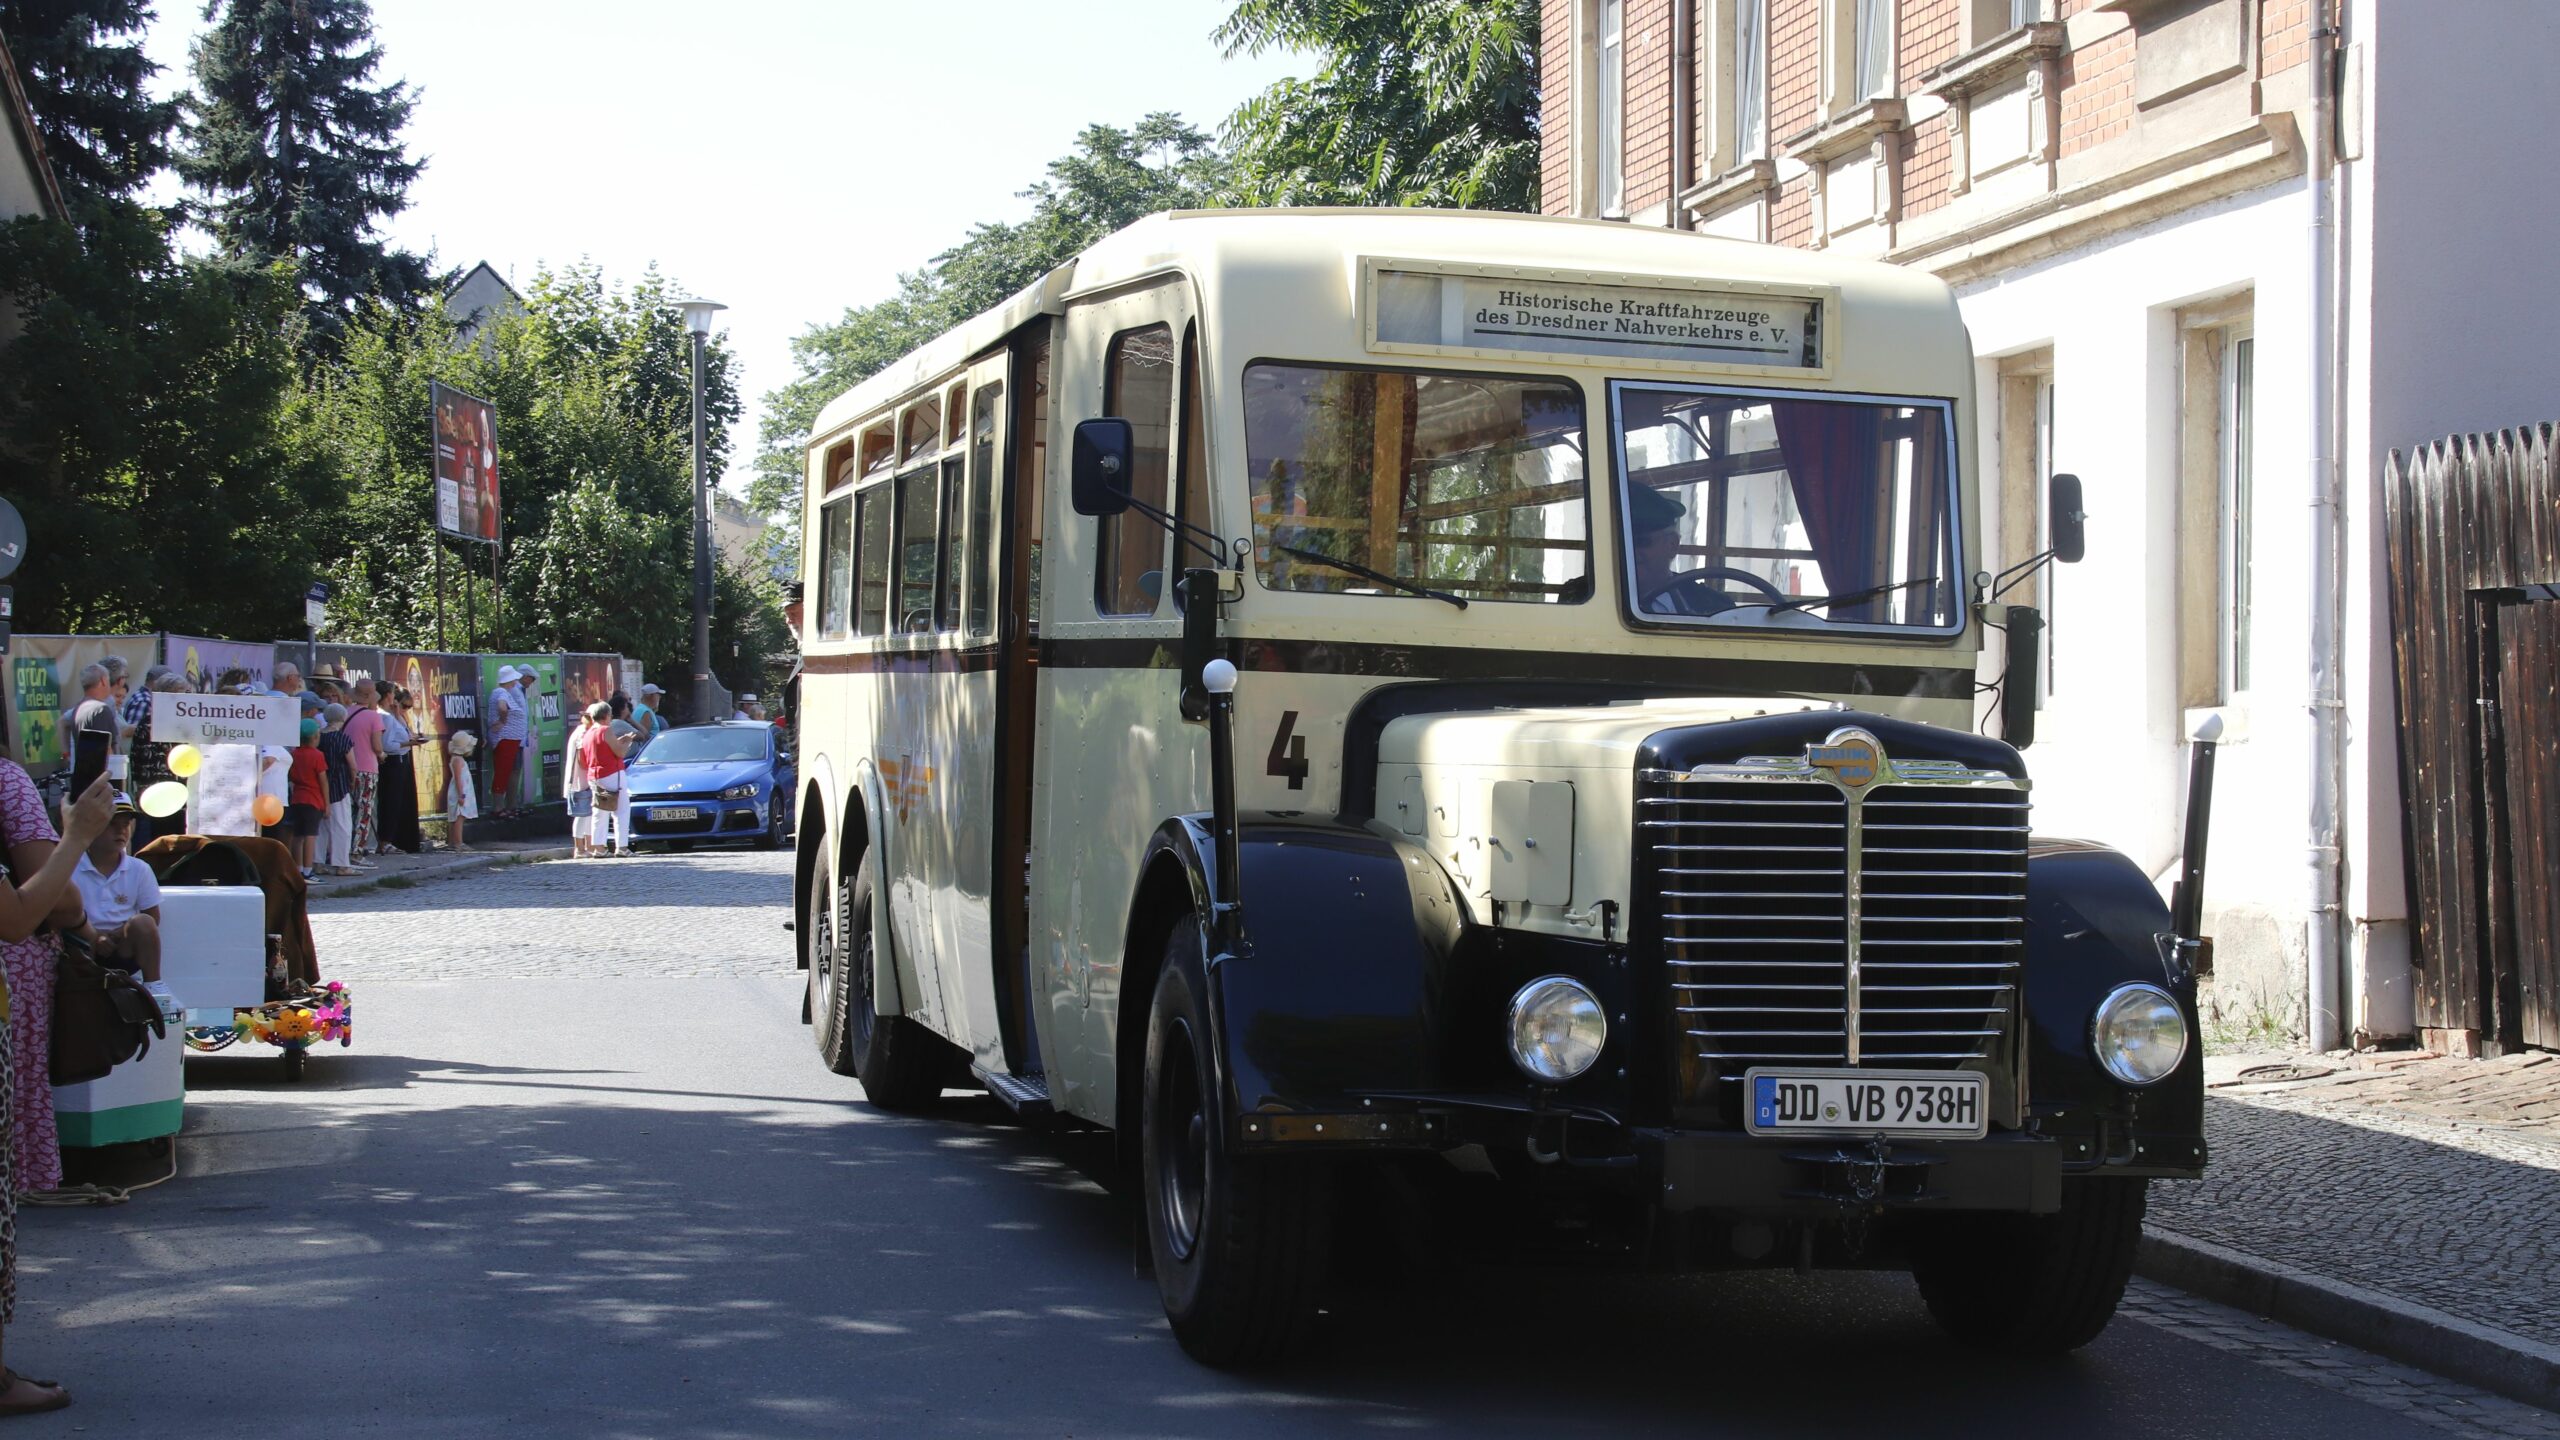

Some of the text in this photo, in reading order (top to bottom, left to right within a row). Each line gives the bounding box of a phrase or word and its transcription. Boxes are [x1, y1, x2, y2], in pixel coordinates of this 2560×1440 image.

[1476, 308, 1789, 344] des Dresdner Nahverkehrs e. V.
[1498, 290, 1770, 326] Historische Kraftfahrzeuge
[176, 701, 266, 720] Schmiede
[541, 694, 560, 718] PARK
[201, 722, 255, 740] Übigau
[1267, 711, 1309, 790] 4
[1761, 1083, 1977, 1123] D DD VB 938H
